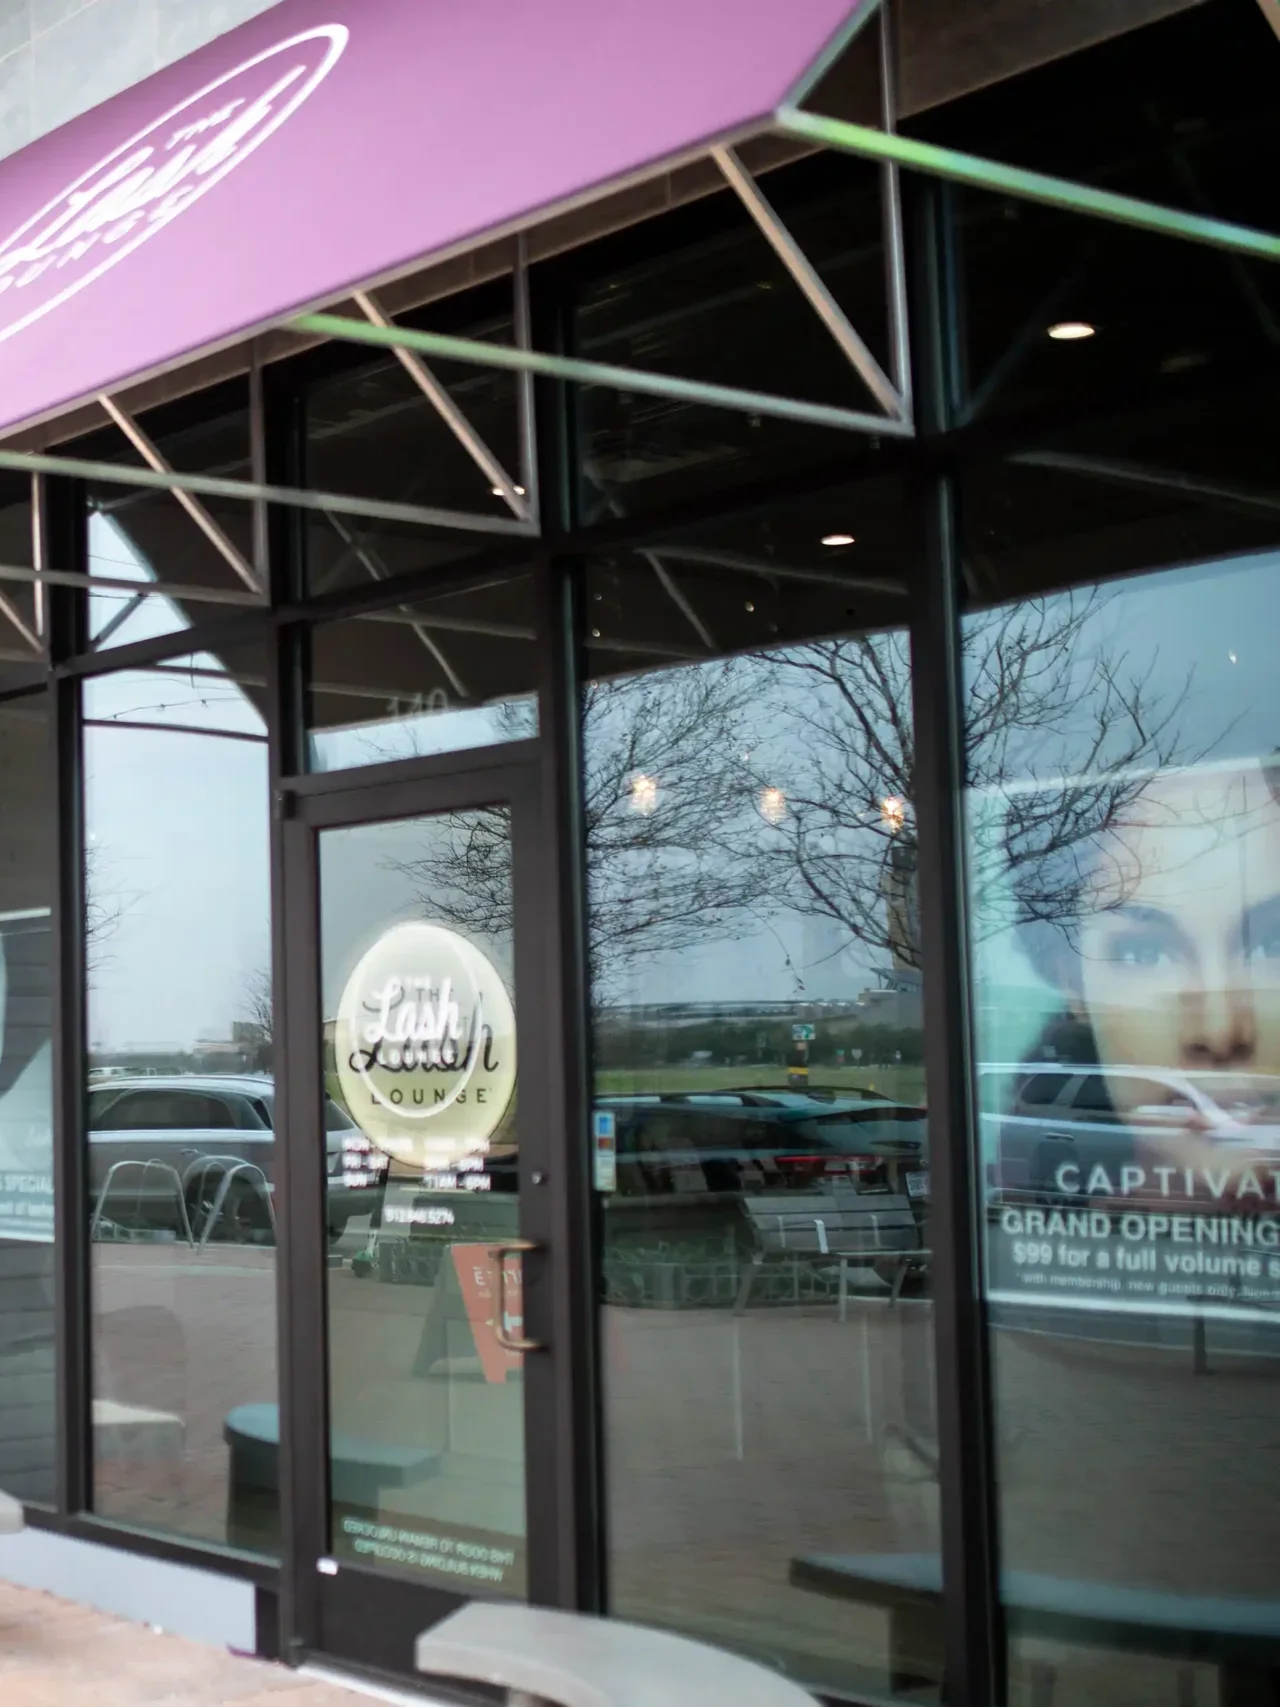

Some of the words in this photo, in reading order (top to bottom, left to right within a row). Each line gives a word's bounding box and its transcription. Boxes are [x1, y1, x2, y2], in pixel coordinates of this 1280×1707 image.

[364, 975, 462, 1043] Lash
[371, 1088, 488, 1105] LOUNGE
[1001, 1207, 1111, 1239] GRAND
[1122, 1213, 1280, 1247] OPENING
[1013, 1240, 1053, 1266] $99
[1058, 1243, 1091, 1268] for
[1096, 1252, 1110, 1269] a
[1116, 1246, 1156, 1271] full
[1164, 1251, 1260, 1277] volume
[1129, 1279, 1154, 1292] new
